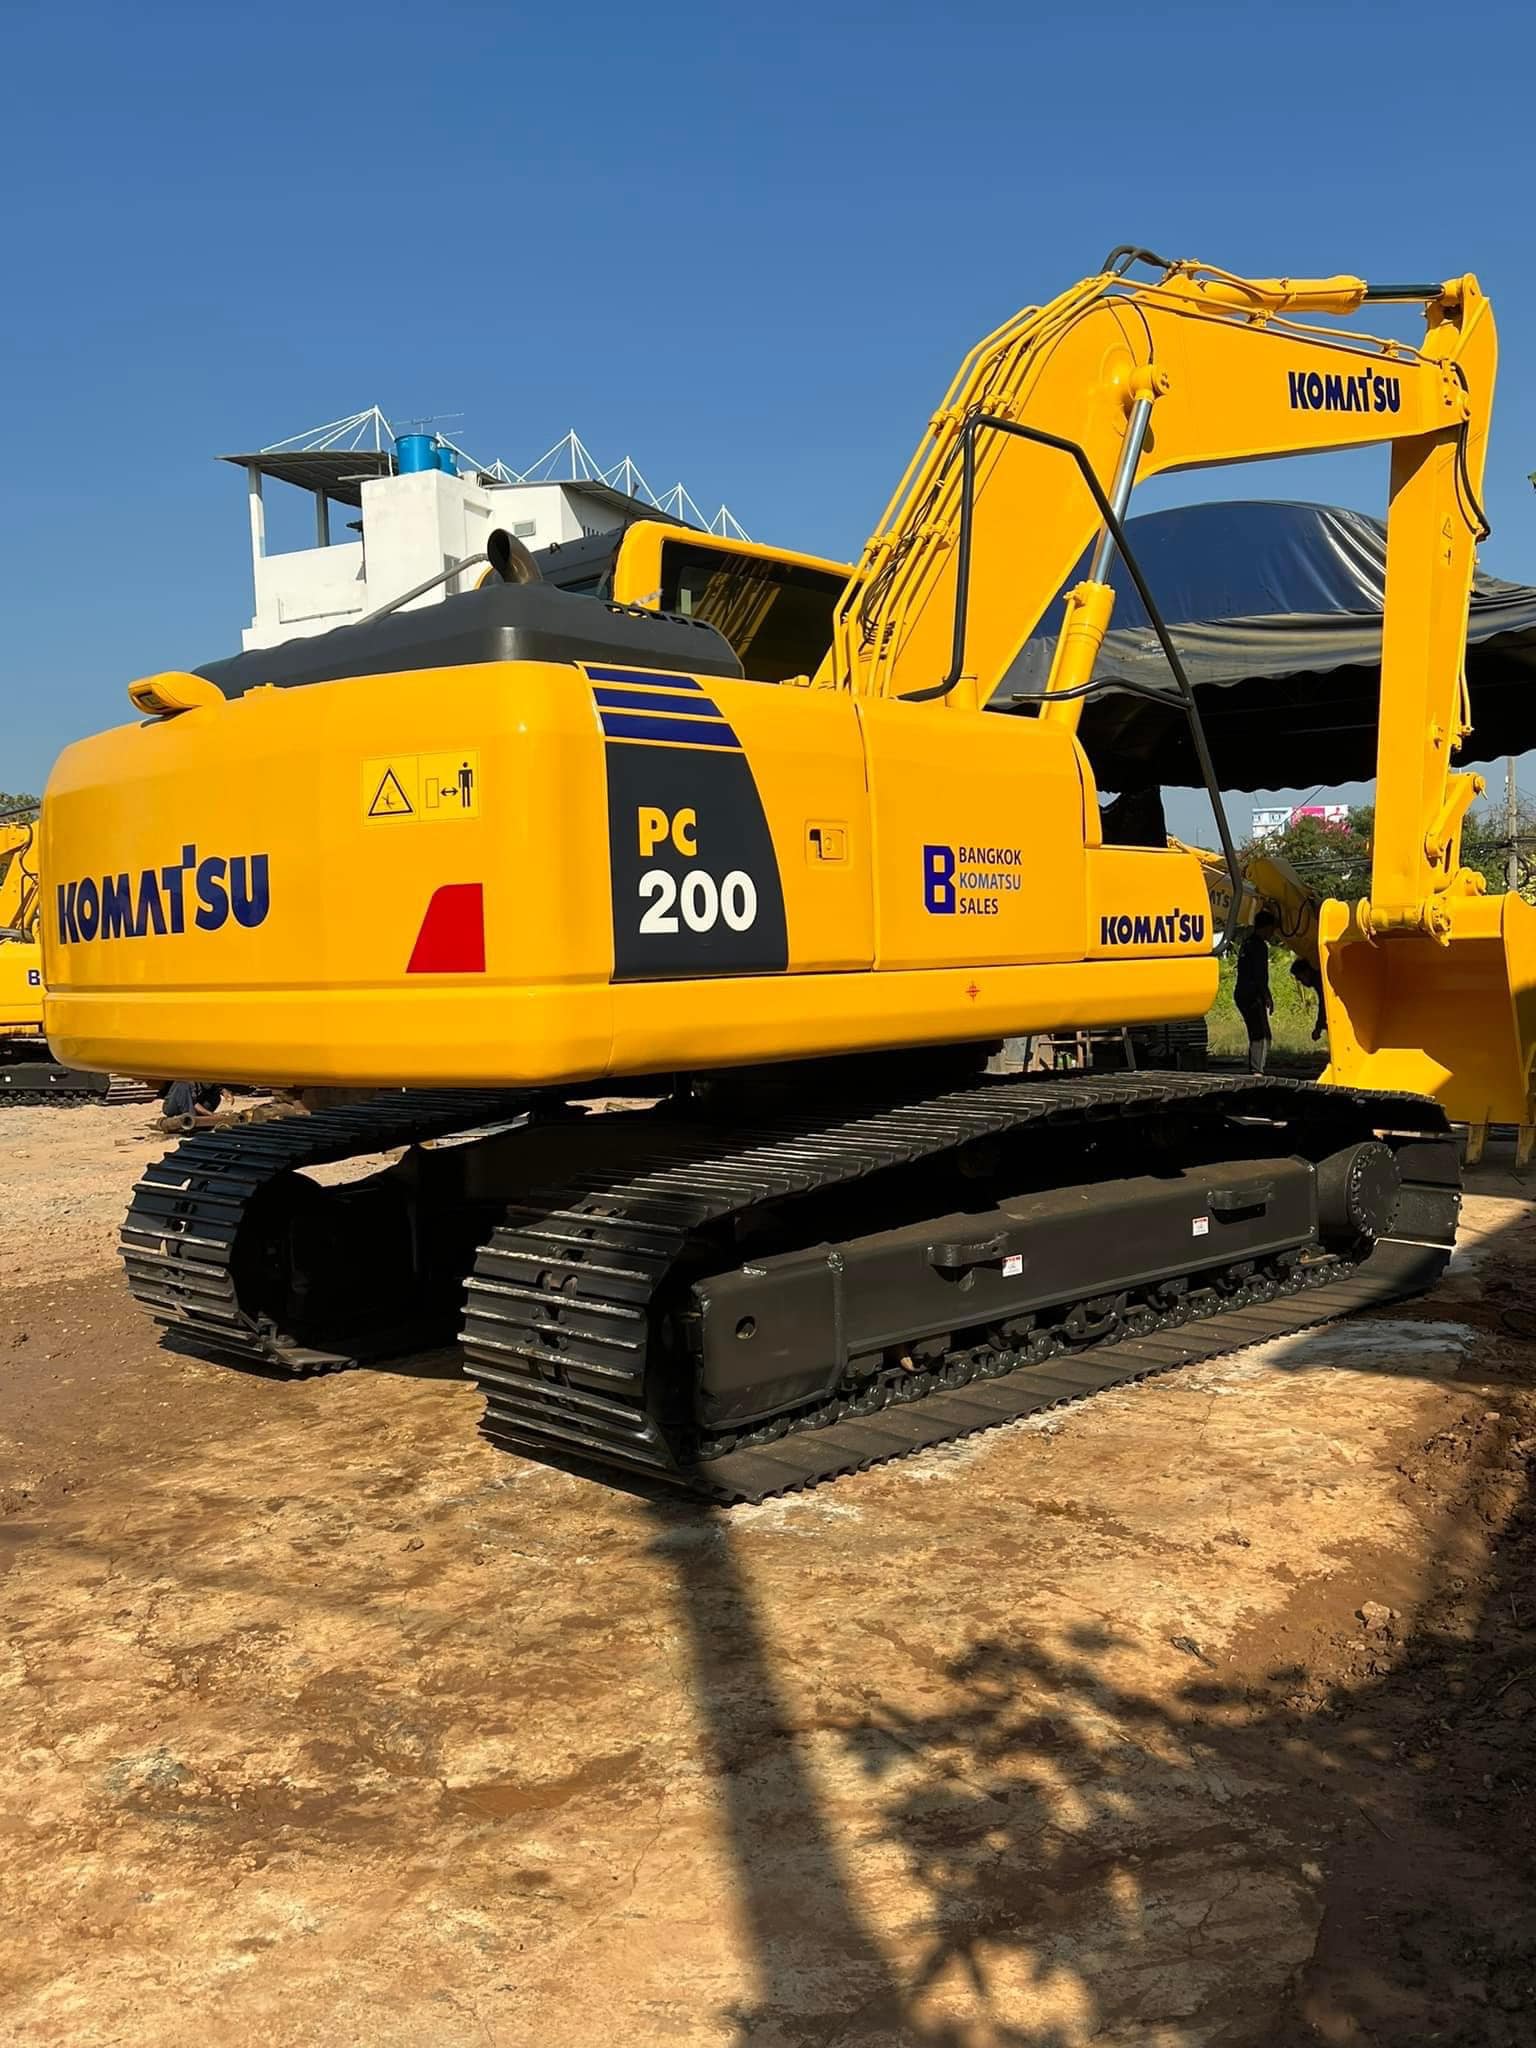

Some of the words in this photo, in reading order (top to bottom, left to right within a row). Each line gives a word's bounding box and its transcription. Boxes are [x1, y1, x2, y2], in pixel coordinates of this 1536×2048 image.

[1288, 367, 1400, 413] KOMATSU
[638, 806, 698, 857] PC
[959, 846, 1022, 866] BANGKOK
[57, 844, 270, 945] KOMATSU
[638, 869, 758, 934] 200
[923, 845, 956, 914] B
[959, 872, 1021, 890] KOMATSU
[959, 897, 999, 915] SALES
[1100, 907, 1205, 945] KOMATSU
